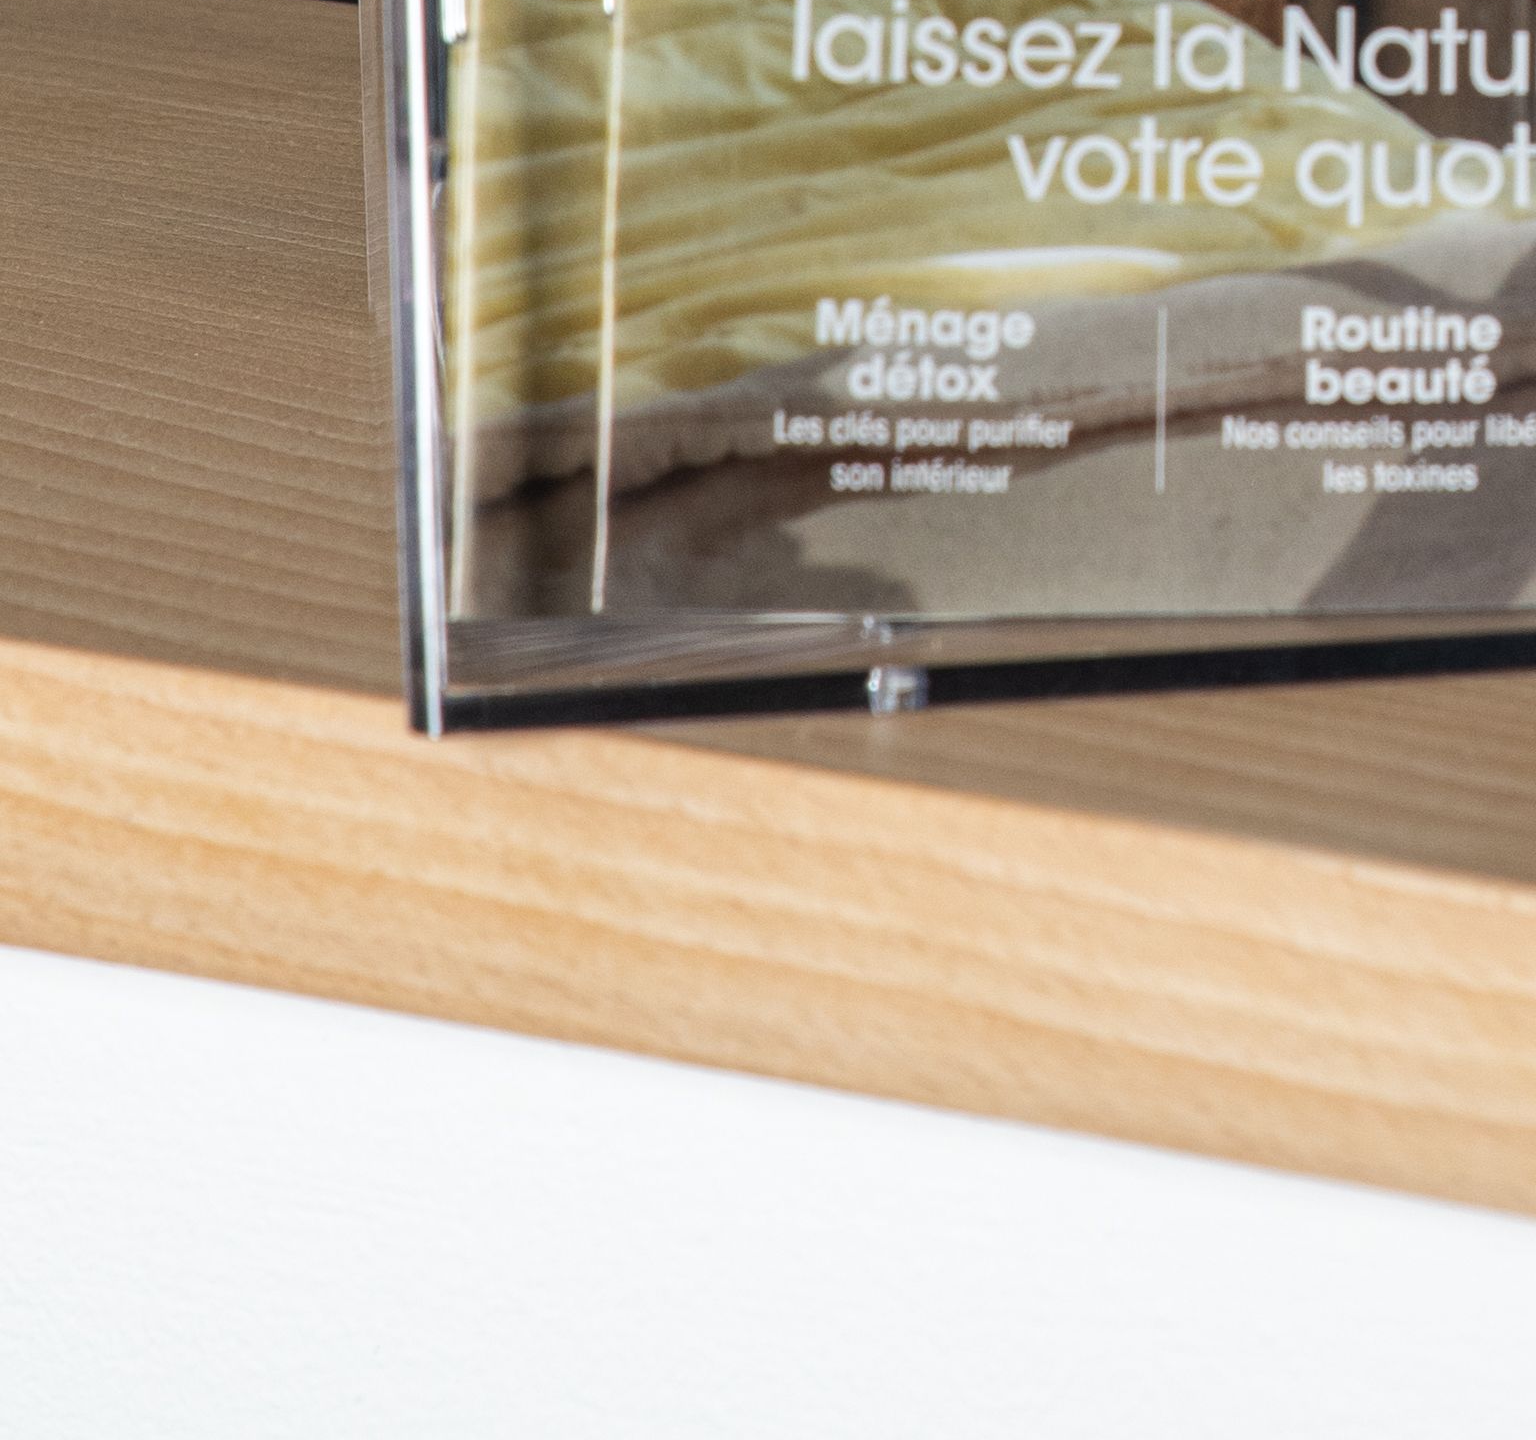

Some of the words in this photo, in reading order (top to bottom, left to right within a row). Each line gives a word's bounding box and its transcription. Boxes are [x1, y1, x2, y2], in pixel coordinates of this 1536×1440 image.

[1155, 3, 1245, 91] la
[1007, 116, 1263, 206] votre
[815, 296, 1035, 355] Ménage
[1301, 305, 1502, 352] Routine
[848, 350, 999, 401] détox
[1305, 354, 1497, 405] beauté
[773, 410, 824, 446] Les
[895, 418, 962, 453] pour
[1222, 415, 1279, 449] Nos
[1411, 419, 1479, 454] pour
[830, 462, 884, 491] son
[1323, 460, 1367, 493] les
